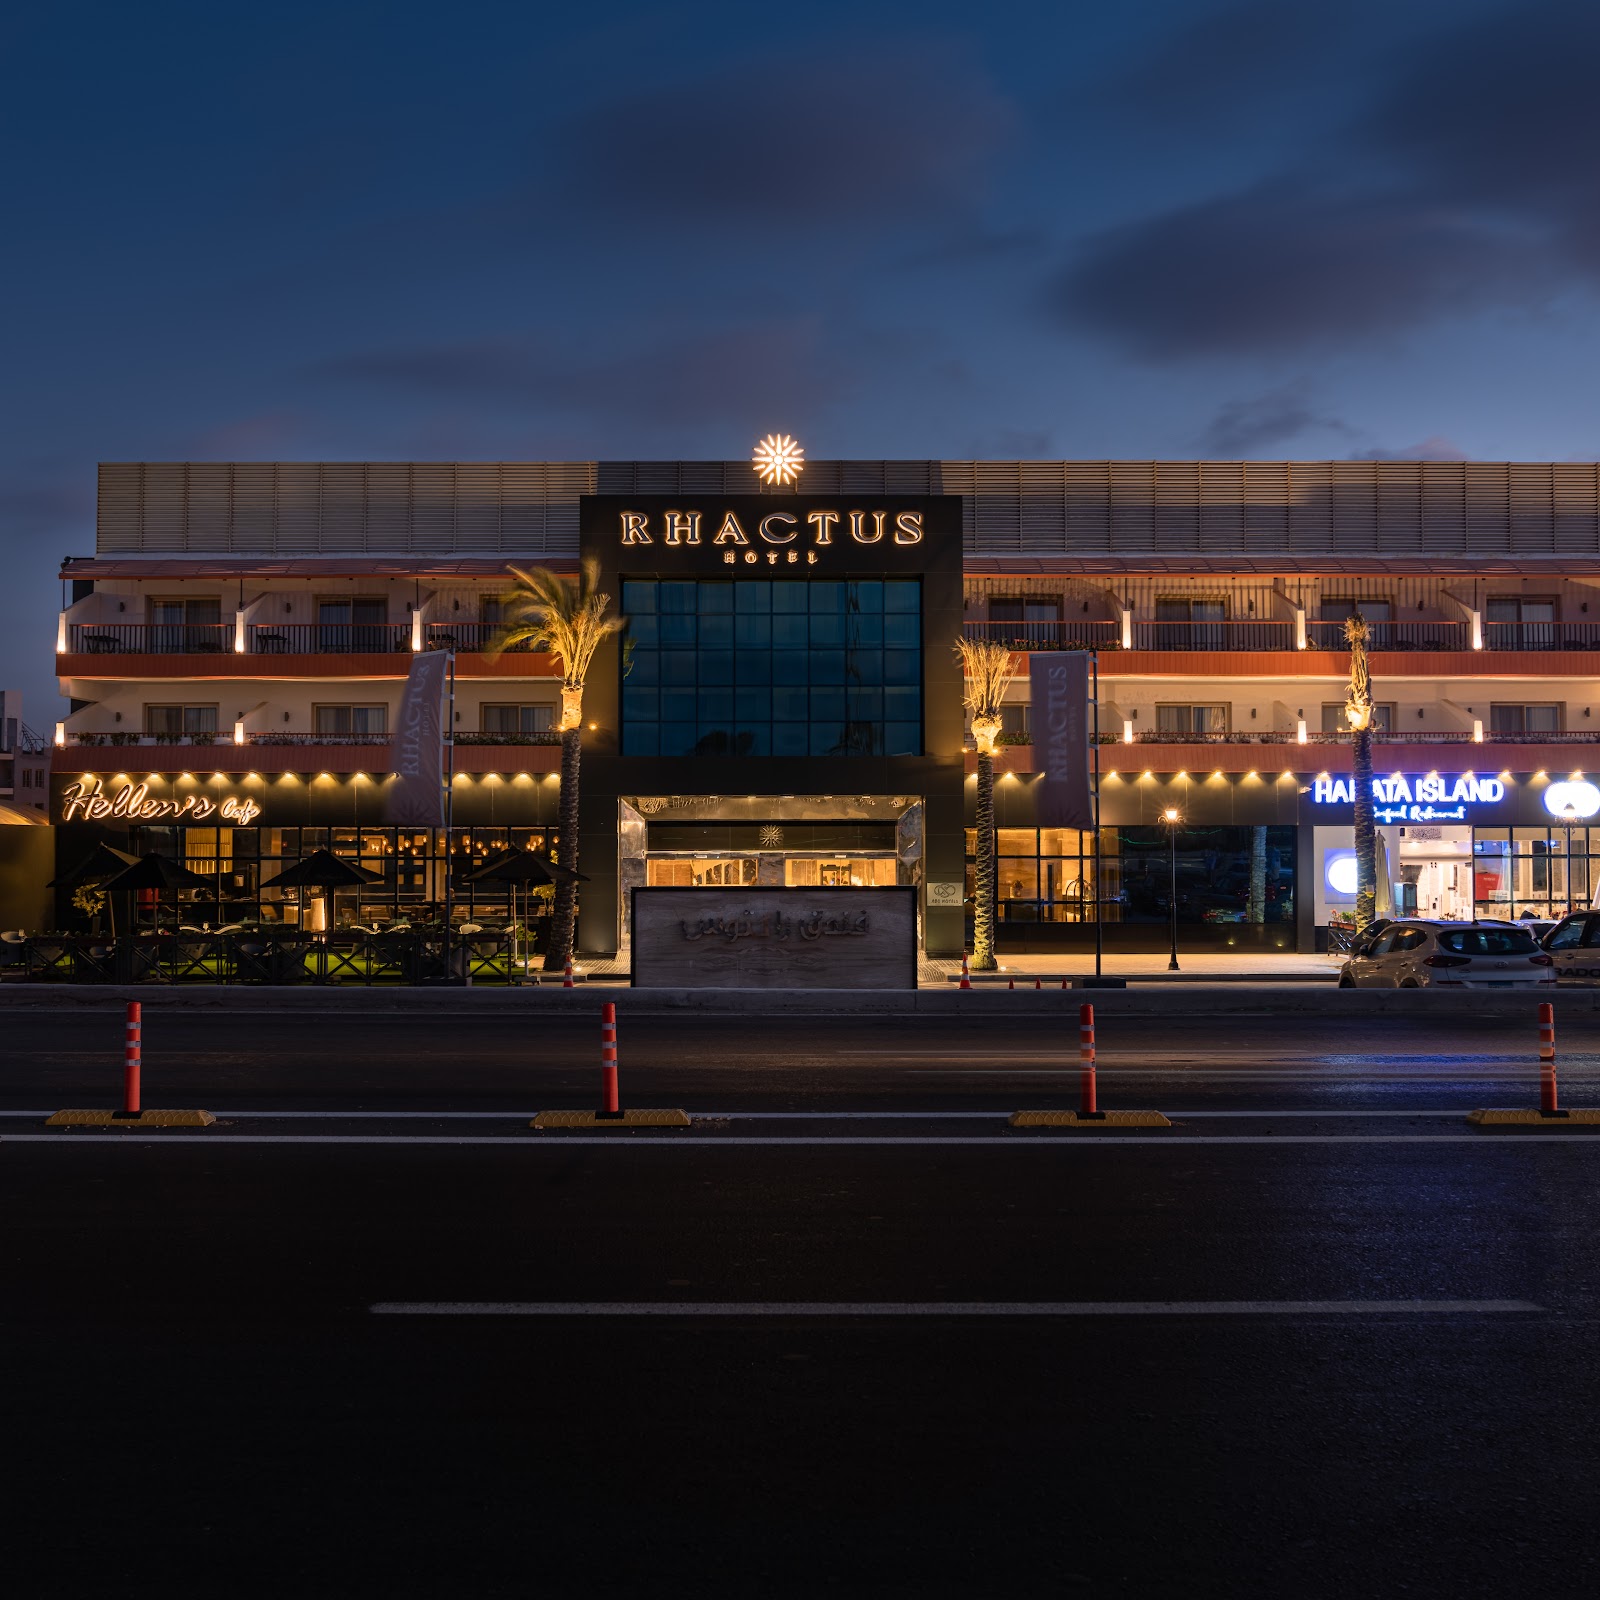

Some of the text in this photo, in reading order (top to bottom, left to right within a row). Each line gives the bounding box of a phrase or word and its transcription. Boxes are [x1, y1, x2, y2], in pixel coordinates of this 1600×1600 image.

[620, 511, 924, 545] RHACTUS
[724, 550, 819, 564] HOTEL
[401, 664, 430, 777] RHACTUS
[1047, 665, 1068, 783] RHACTUS
[63, 779, 261, 826] Hellen's Cafe
[1415, 778, 1505, 803] ISLAND
